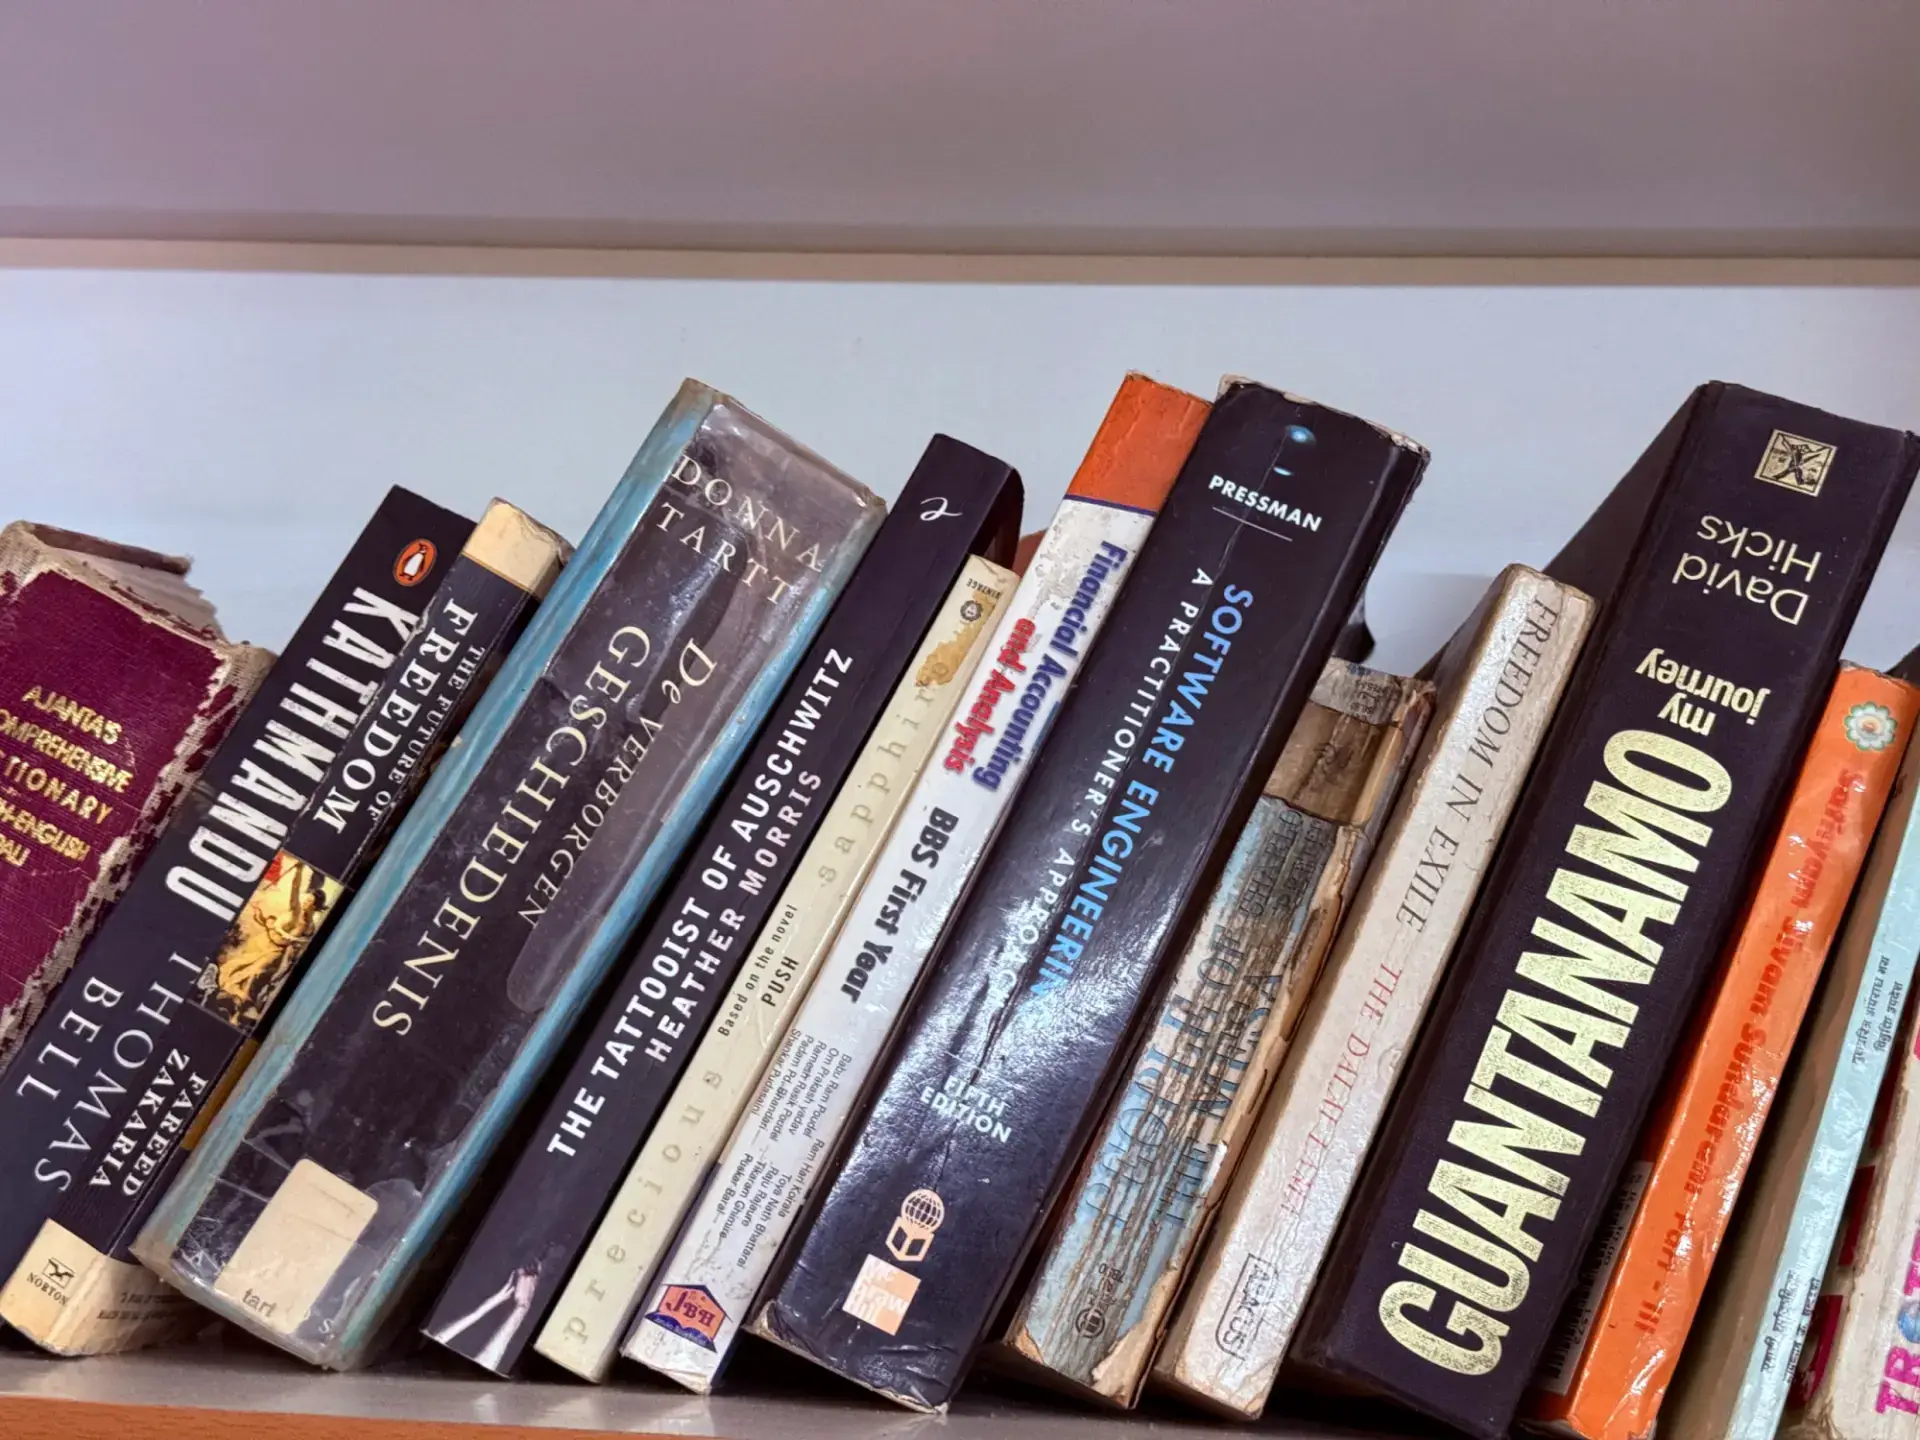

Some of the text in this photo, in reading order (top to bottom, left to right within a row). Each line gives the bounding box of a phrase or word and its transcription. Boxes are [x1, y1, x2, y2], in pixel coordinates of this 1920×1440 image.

[671, 455, 826, 573] DONNA
[1208, 474, 1323, 533] PRESSMAN
[1696, 514, 1822, 583] Hicks
[655, 502, 801, 605] TARTT
[1191, 568, 1215, 586] A
[1672, 552, 1809, 626] David
[943, 617, 1036, 774] and Analysis
[972, 540, 1128, 791] Financial Accounting
[1467, 598, 1559, 770] FREEDOM
[1635, 648, 1771, 726] journey
[166, 587, 421, 921] KATHMANDU
[312, 599, 478, 835] FREEDOM
[367, 646, 486, 823] THE FUTURE OF
[1071, 600, 1200, 837] PRACTITIONER'S
[1657, 696, 1716, 737] my
[0, 752, 113, 824] TIONARY
[371, 625, 651, 1035] GESCHIEDENIS
[517, 638, 717, 928] De VERBORGEN
[1020, 583, 1255, 1020] SOFTWARE ENGINEERIN
[1445, 780, 1487, 824] IN
[547, 648, 854, 1158] THE TATTOOIST OF AUSCHWITZ
[645, 770, 822, 1063] HEATHER MORRIS
[840, 806, 959, 1004] BBS First Year
[1396, 825, 1460, 934] EXILE
[717, 904, 798, 1037] Based on the novel
[761, 956, 800, 1007] PUSH
[1359, 960, 1403, 1027] THE
[15, 976, 125, 1100] BELL
[34, 951, 204, 1192] THOMAS
[774, 1027, 801, 1068] Shankar
[788, 1033, 813, 1069] Padam
[1318, 1031, 1372, 1126] DALAI
[1378, 729, 1732, 1375] GUANTANAMO
[88, 1047, 192, 1188] ZAKARIA
[122, 1069, 209, 1199] FAREED
[767, 1039, 826, 1142] Ramesh Rasik Poudel
[786, 1046, 839, 1136] Om Prakash yadav
[801, 1052, 852, 1138] Babu Ram Poudel
[921, 1087, 1012, 1143] EDITION
[944, 1075, 1009, 1116] FIFTH
[715, 1152, 753, 1214] Puskar Baral
[718, 1159, 766, 1240] Tikaram Ghimire
[735, 1171, 791, 1268] Toya Nath Bhattarai
[739, 1164, 778, 1227] Raju Rajaure
[777, 1137, 825, 1219] Ram Hari Koirala
[26, 1272, 70, 1306] NORTON
[241, 1286, 281, 1319] tart
[663, 1284, 720, 1330] JBH
[1222, 1262, 1275, 1348] ABACUS
